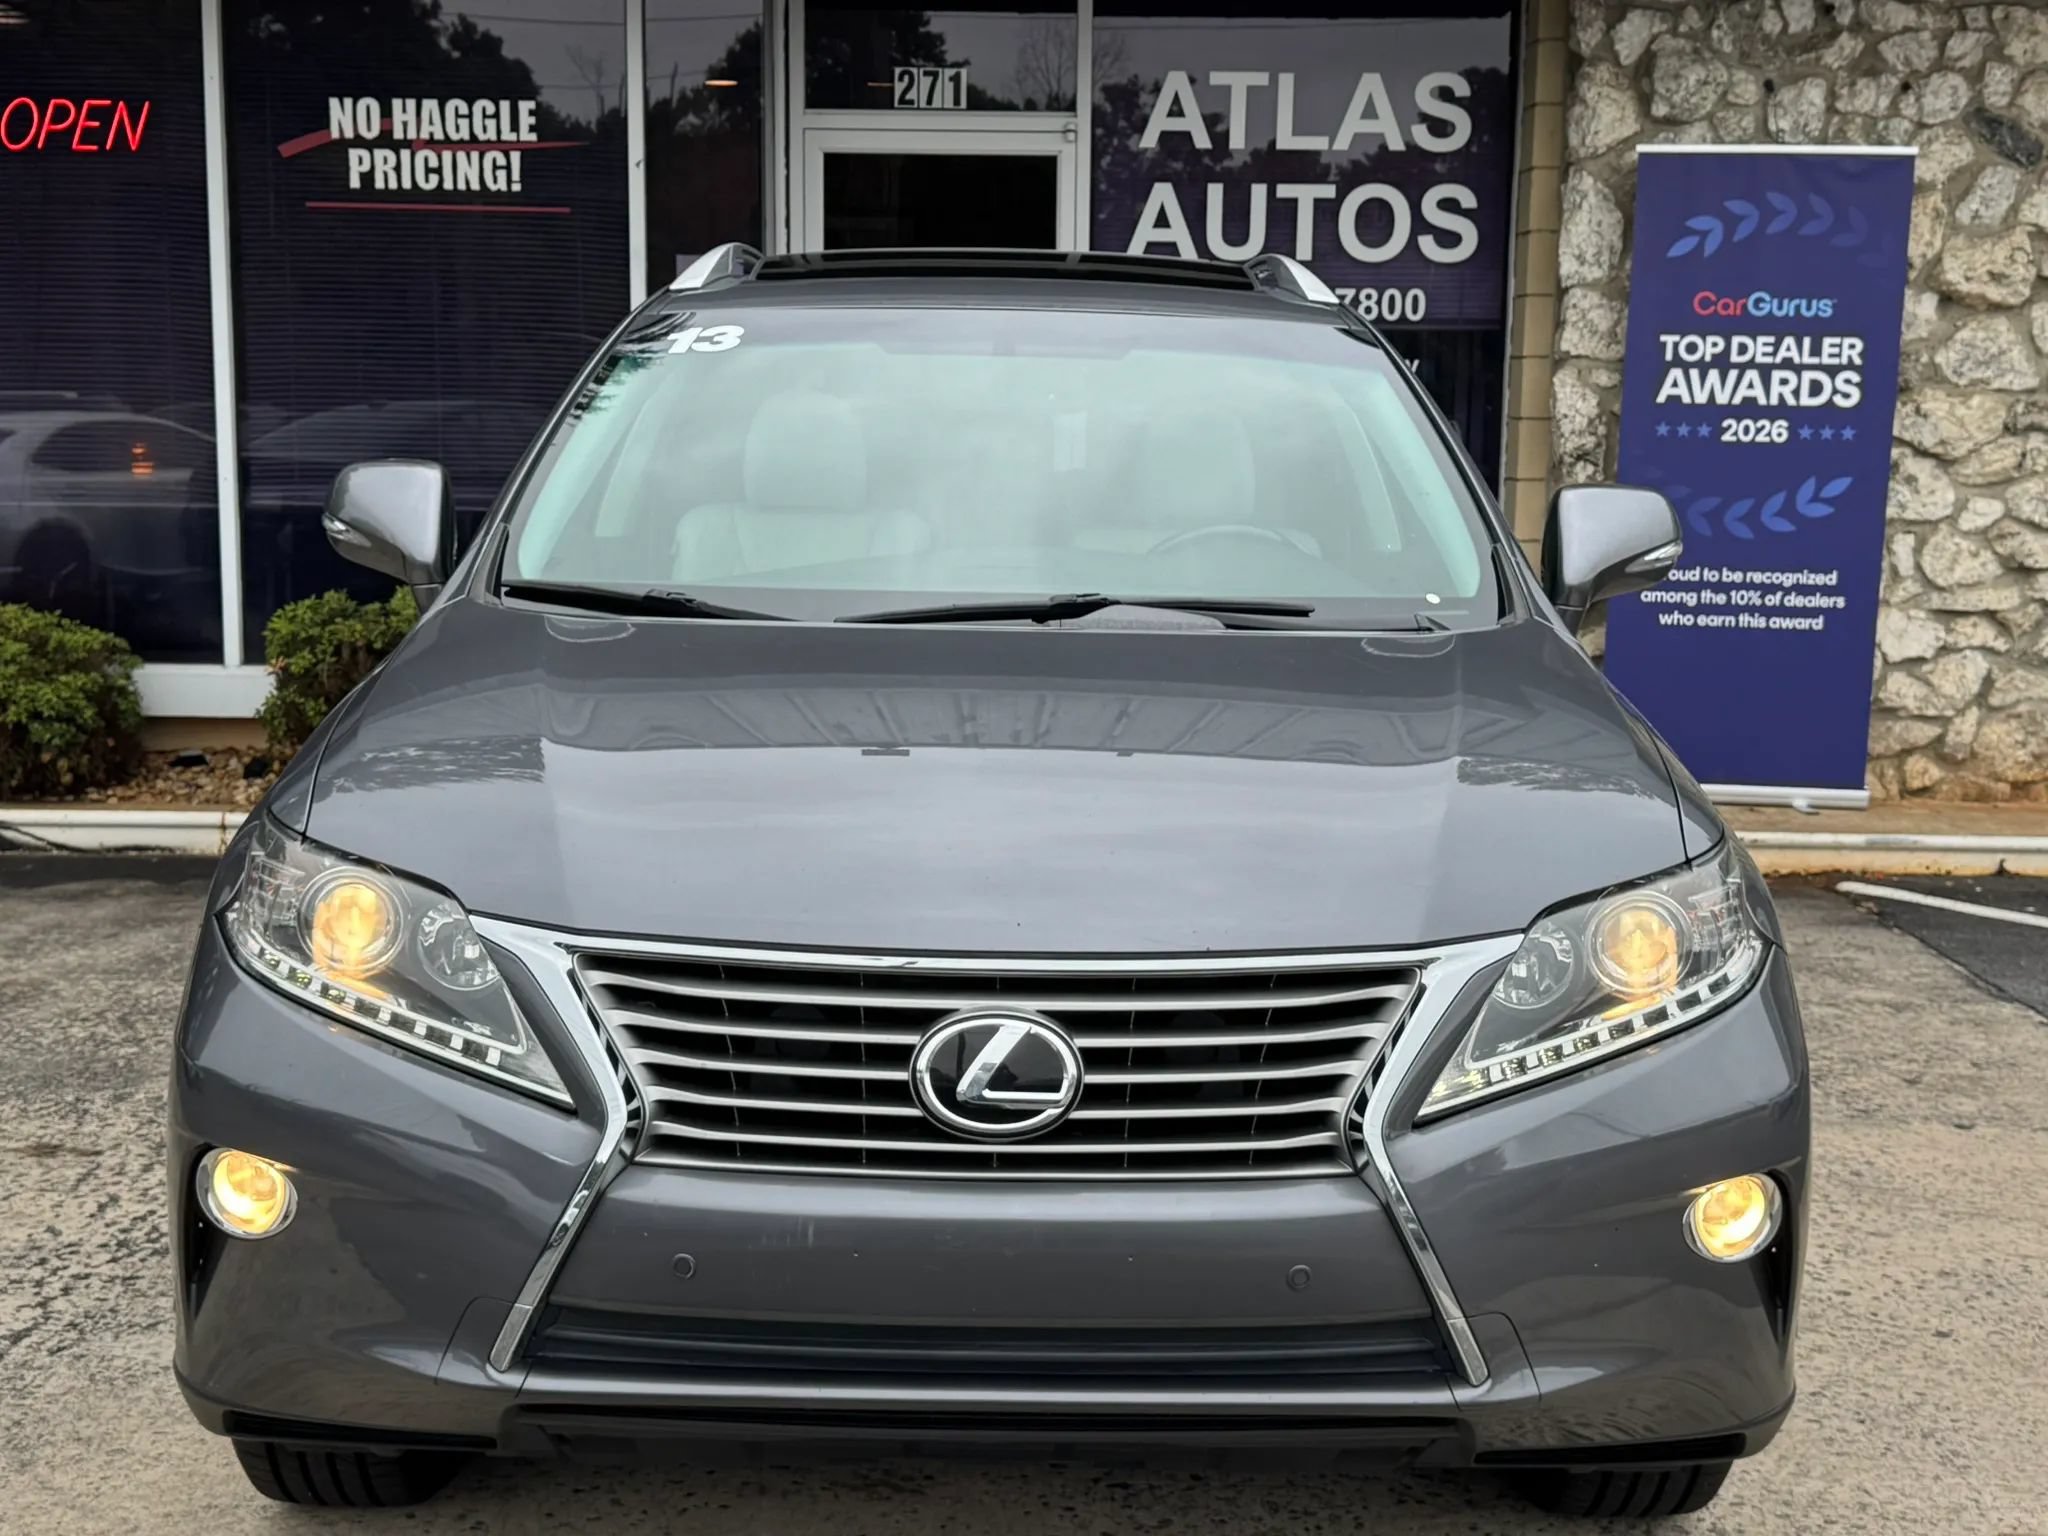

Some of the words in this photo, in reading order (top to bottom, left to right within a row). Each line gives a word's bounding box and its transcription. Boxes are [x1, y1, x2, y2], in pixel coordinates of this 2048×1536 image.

[897, 69, 962, 107] 271
[0, 97, 150, 152] OPEN
[328, 96, 382, 140] NO
[391, 98, 539, 142] HAGGLE
[1138, 70, 1473, 153] ATLAS
[347, 148, 523, 192] PRICING!
[1125, 181, 1480, 264] AUTOS
[1692, 290, 1835, 318] CarGurus
[667, 325, 745, 354] 13
[1659, 334, 1726, 363] TOP
[1729, 335, 1864, 366] DEALER
[1655, 367, 1862, 408] AWARDS
[1720, 418, 1790, 443] 2026
[1664, 566, 1700, 582] oud
[1703, 567, 1719, 582] to
[1721, 567, 1744, 583] be
[1746, 569, 1838, 588] recognized
[1640, 590, 1698, 607] among
[1700, 589, 1727, 605] the
[1729, 590, 1762, 607] 10%
[1764, 592, 1783, 607] of
[1784, 592, 1846, 609] dealers
[1658, 610, 1694, 627] who
[1697, 615, 1736, 628] earn
[1738, 612, 1767, 629] this
[1769, 614, 1824, 631] award
